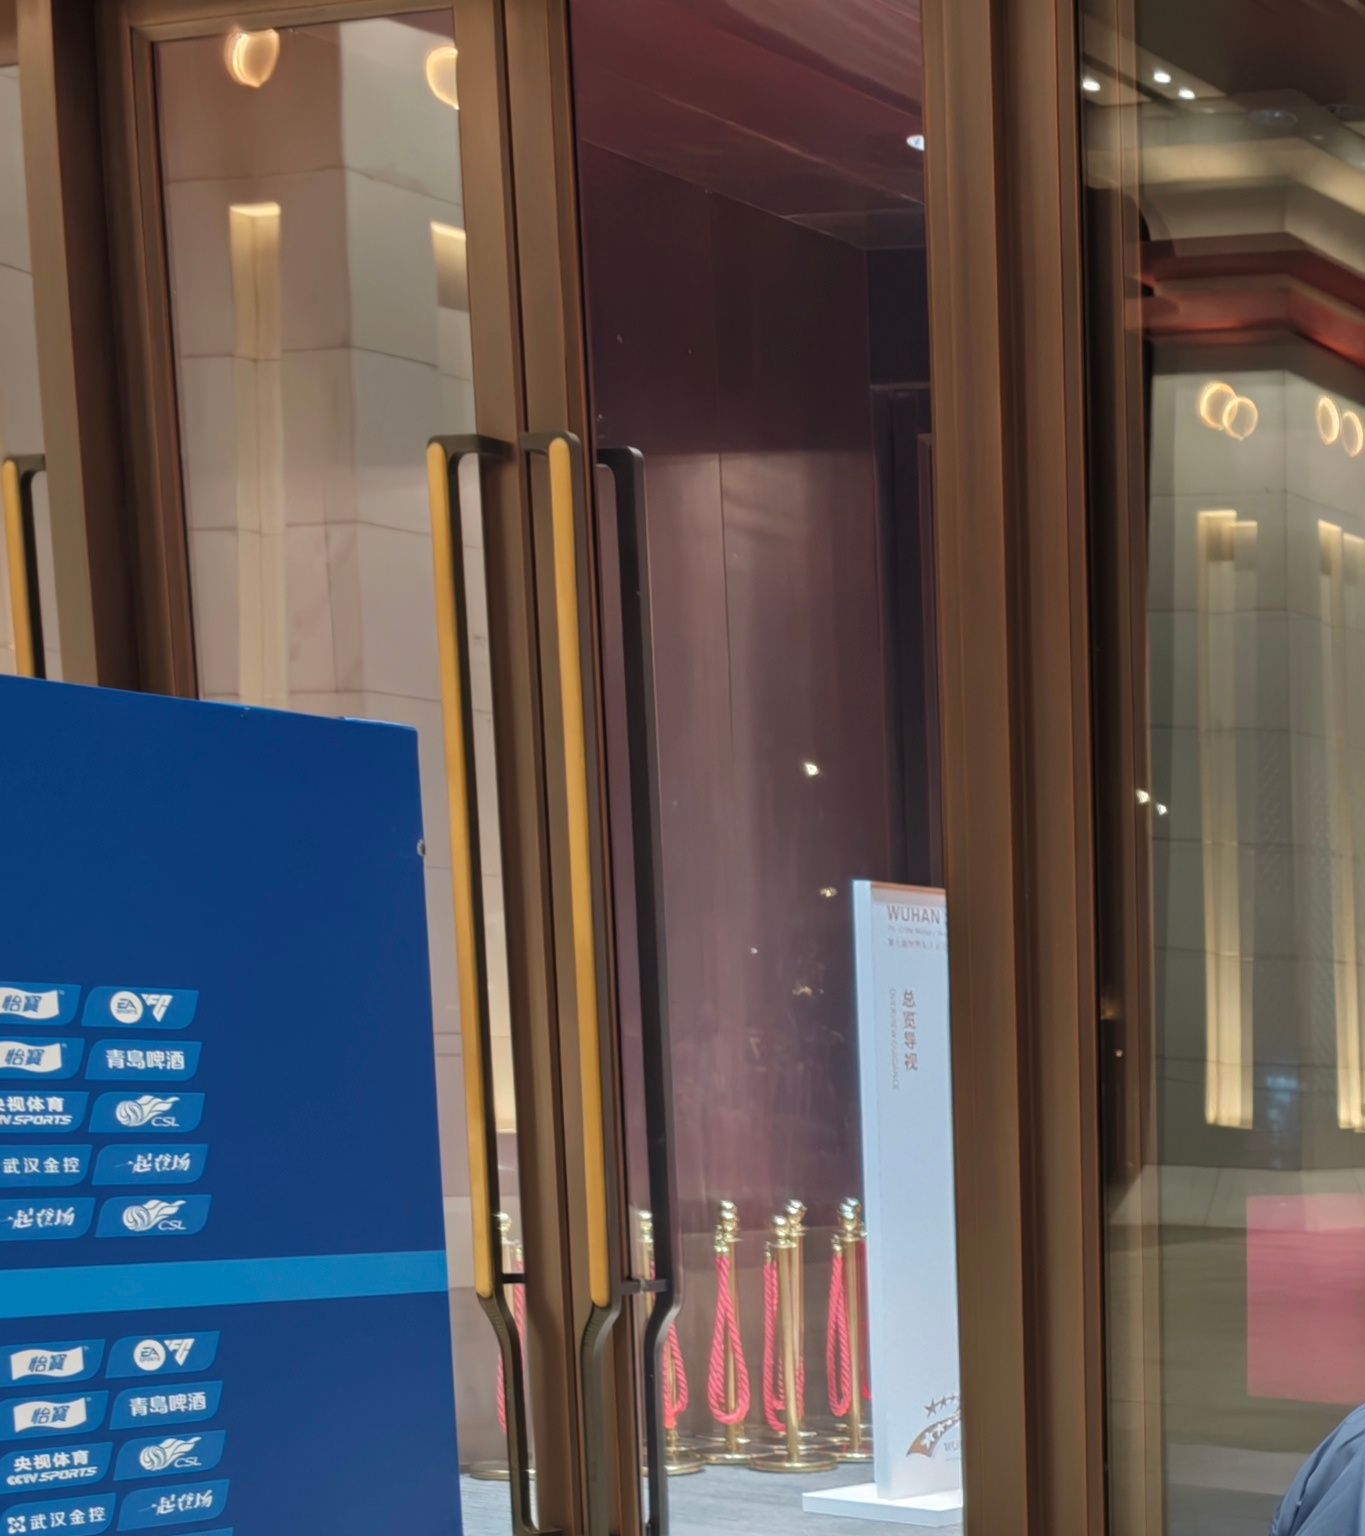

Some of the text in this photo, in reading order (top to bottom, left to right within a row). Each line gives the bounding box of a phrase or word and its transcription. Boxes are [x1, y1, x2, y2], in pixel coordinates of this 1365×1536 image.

[886, 904, 940, 924] WUHAN
[116, 998, 136, 1010] EA
[12, 1115, 73, 1125] SPORTS
[151, 1116, 180, 1127] CSL
[2, 1157, 80, 1174] 武汉金控
[157, 1220, 187, 1231] CSL
[140, 1346, 160, 1359] EA
[14, 1450, 89, 1472] 央视体育
[174, 1457, 202, 1468] CSL
[39, 1467, 98, 1482] SPORTS
[30, 1507, 106, 1531] 武汉金控
